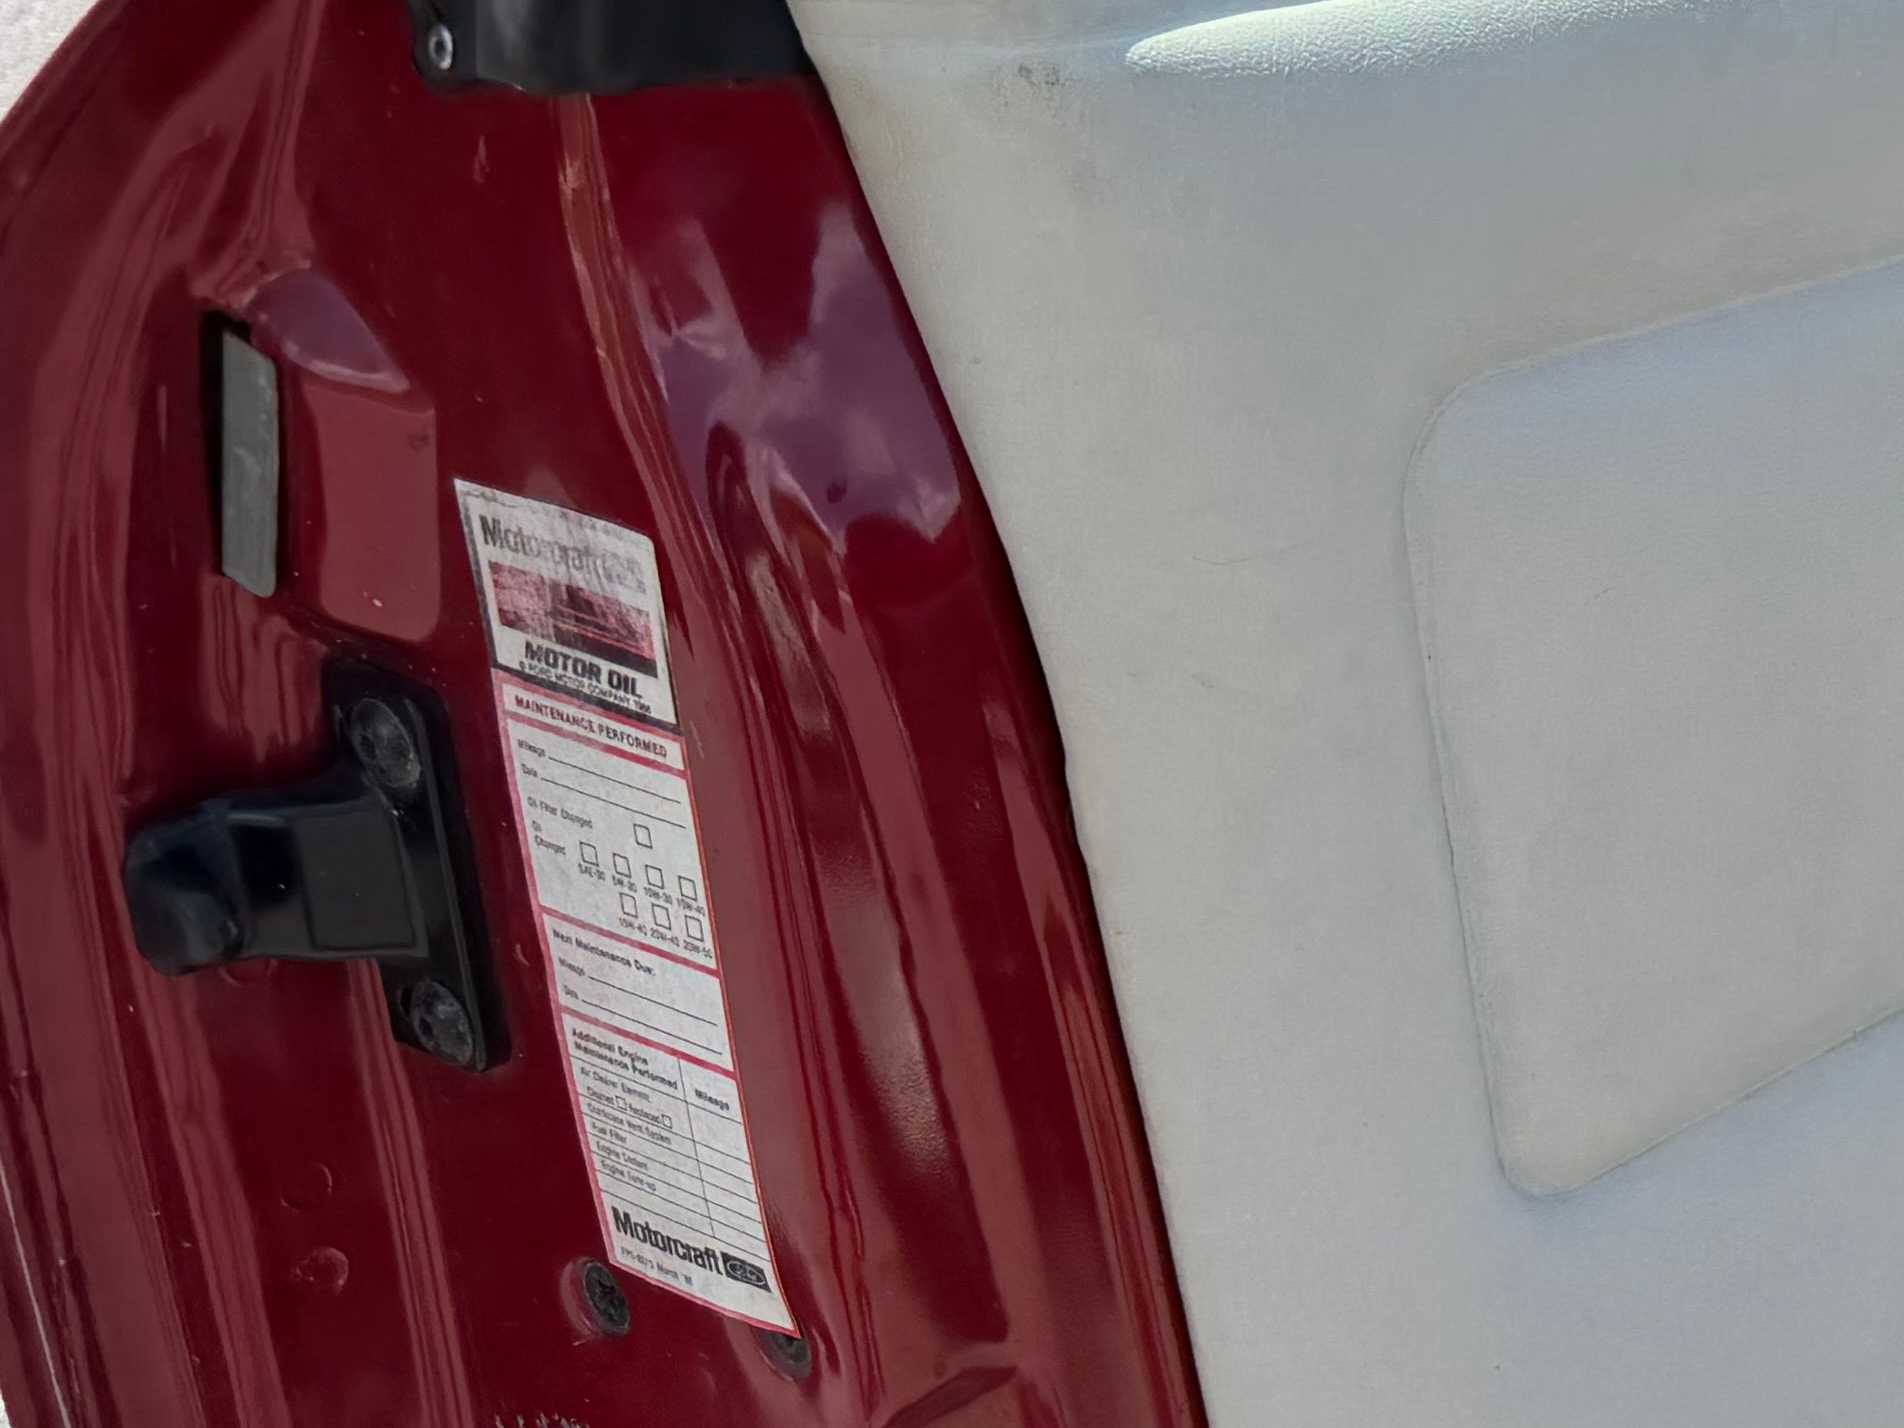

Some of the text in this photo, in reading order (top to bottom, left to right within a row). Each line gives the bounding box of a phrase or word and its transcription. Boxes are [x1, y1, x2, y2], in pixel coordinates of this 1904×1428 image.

[524, 641, 641, 699] MOTOR OIL
[516, 695, 667, 757] MAINTENANCE PERFORMED
[575, 936, 631, 967] Maintenance
[612, 1206, 722, 1274] Motorcraft
